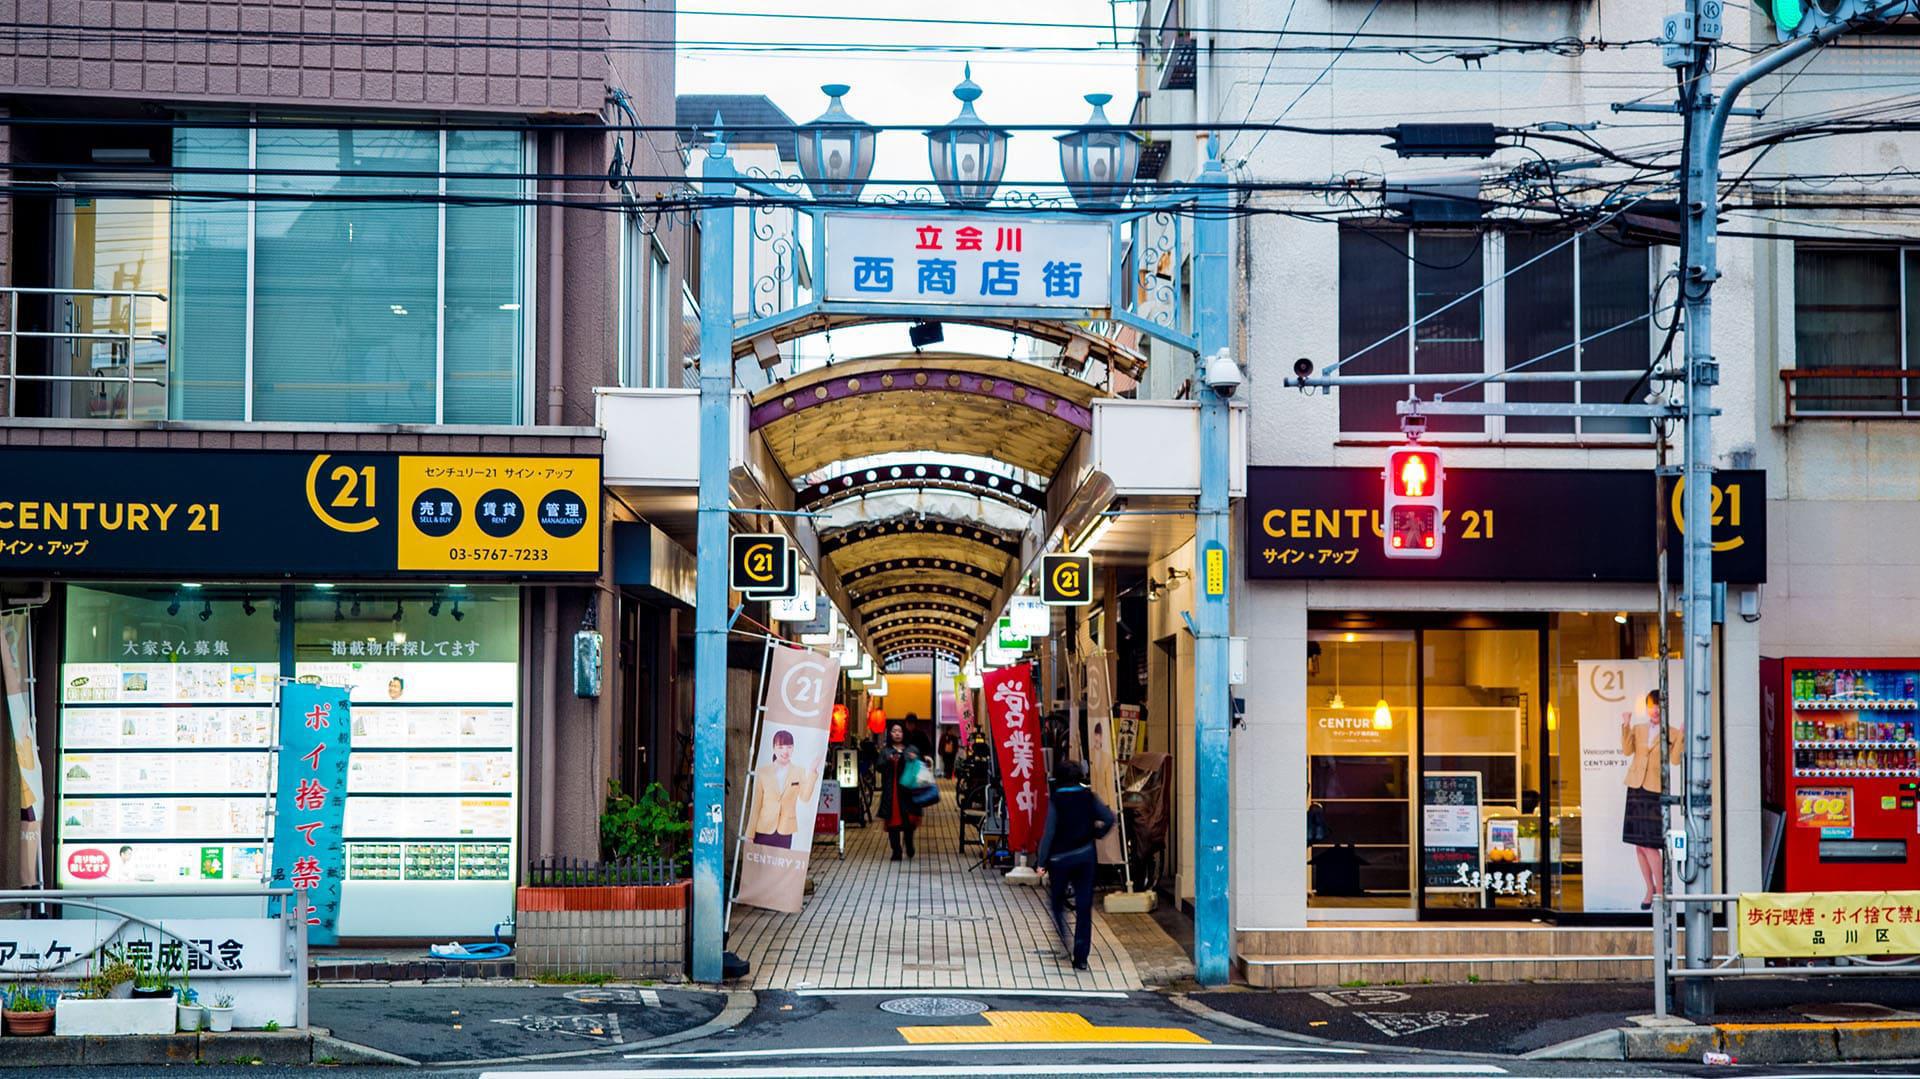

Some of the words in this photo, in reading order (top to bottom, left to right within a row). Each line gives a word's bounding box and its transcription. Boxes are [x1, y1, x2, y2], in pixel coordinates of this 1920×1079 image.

[915, 225, 1023, 252] 立会川
[853, 256, 1083, 298] 西商店街
[0, 502, 178, 531] CENTURY
[187, 503, 220, 531] 21
[419, 501, 454, 516] 売買
[483, 502, 517, 517] 賃貸
[546, 503, 580, 517] 管理
[1461, 509, 1494, 538] 21
[449, 548, 549, 561] 03-5767-7233
[1263, 548, 1359, 564] サイン・アップ
[122, 640, 230, 656] 大家さん募集
[331, 640, 481, 656] 掲載物件探してます
[1319, 717, 1373, 729] CENTUR
[993, 680, 1038, 826] 営業中
[1800, 799, 1845, 815] 100
[746, 851, 793, 868] CENTURY
[795, 860, 806, 871] 21
[1812, 929, 1890, 945] 品川区
